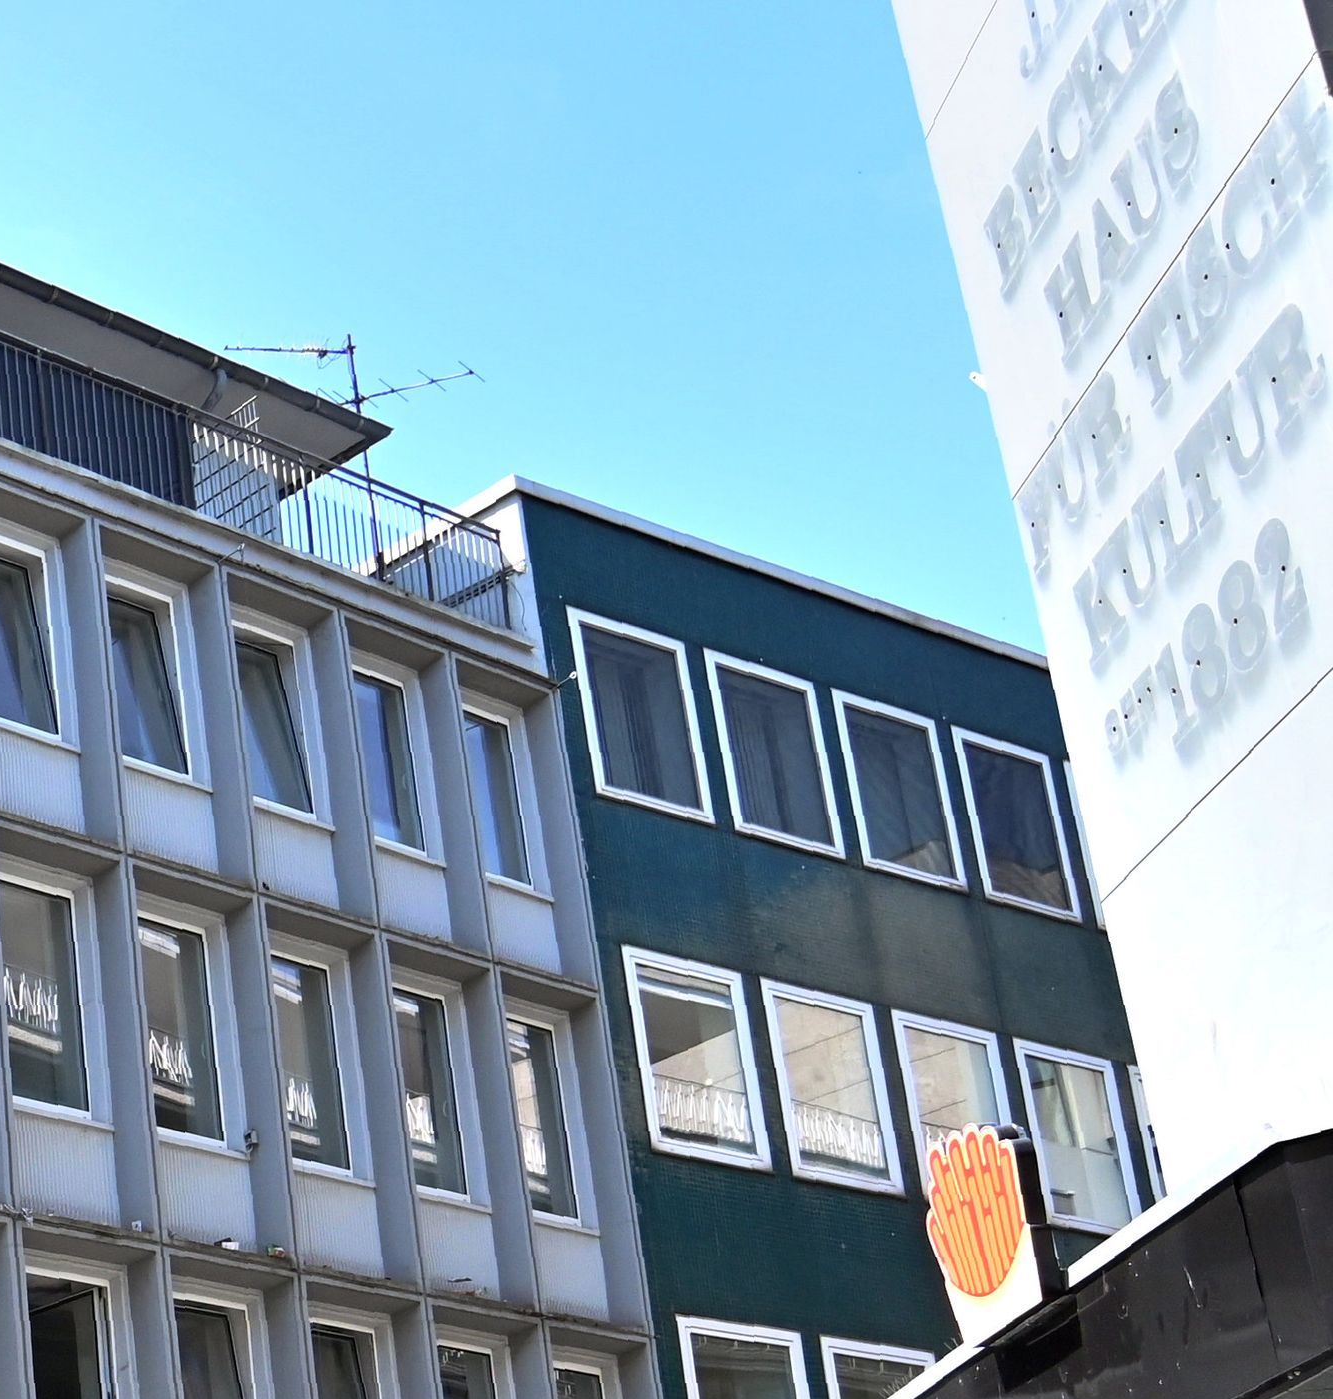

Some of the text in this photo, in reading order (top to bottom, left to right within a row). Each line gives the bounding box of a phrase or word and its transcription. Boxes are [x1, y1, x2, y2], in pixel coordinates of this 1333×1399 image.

[1044, 70, 1200, 364] HAUS
[1018, 372, 1132, 576] FÜR
[1073, 303, 1326, 672] KULTUR
[1154, 518, 1310, 750] 1882
